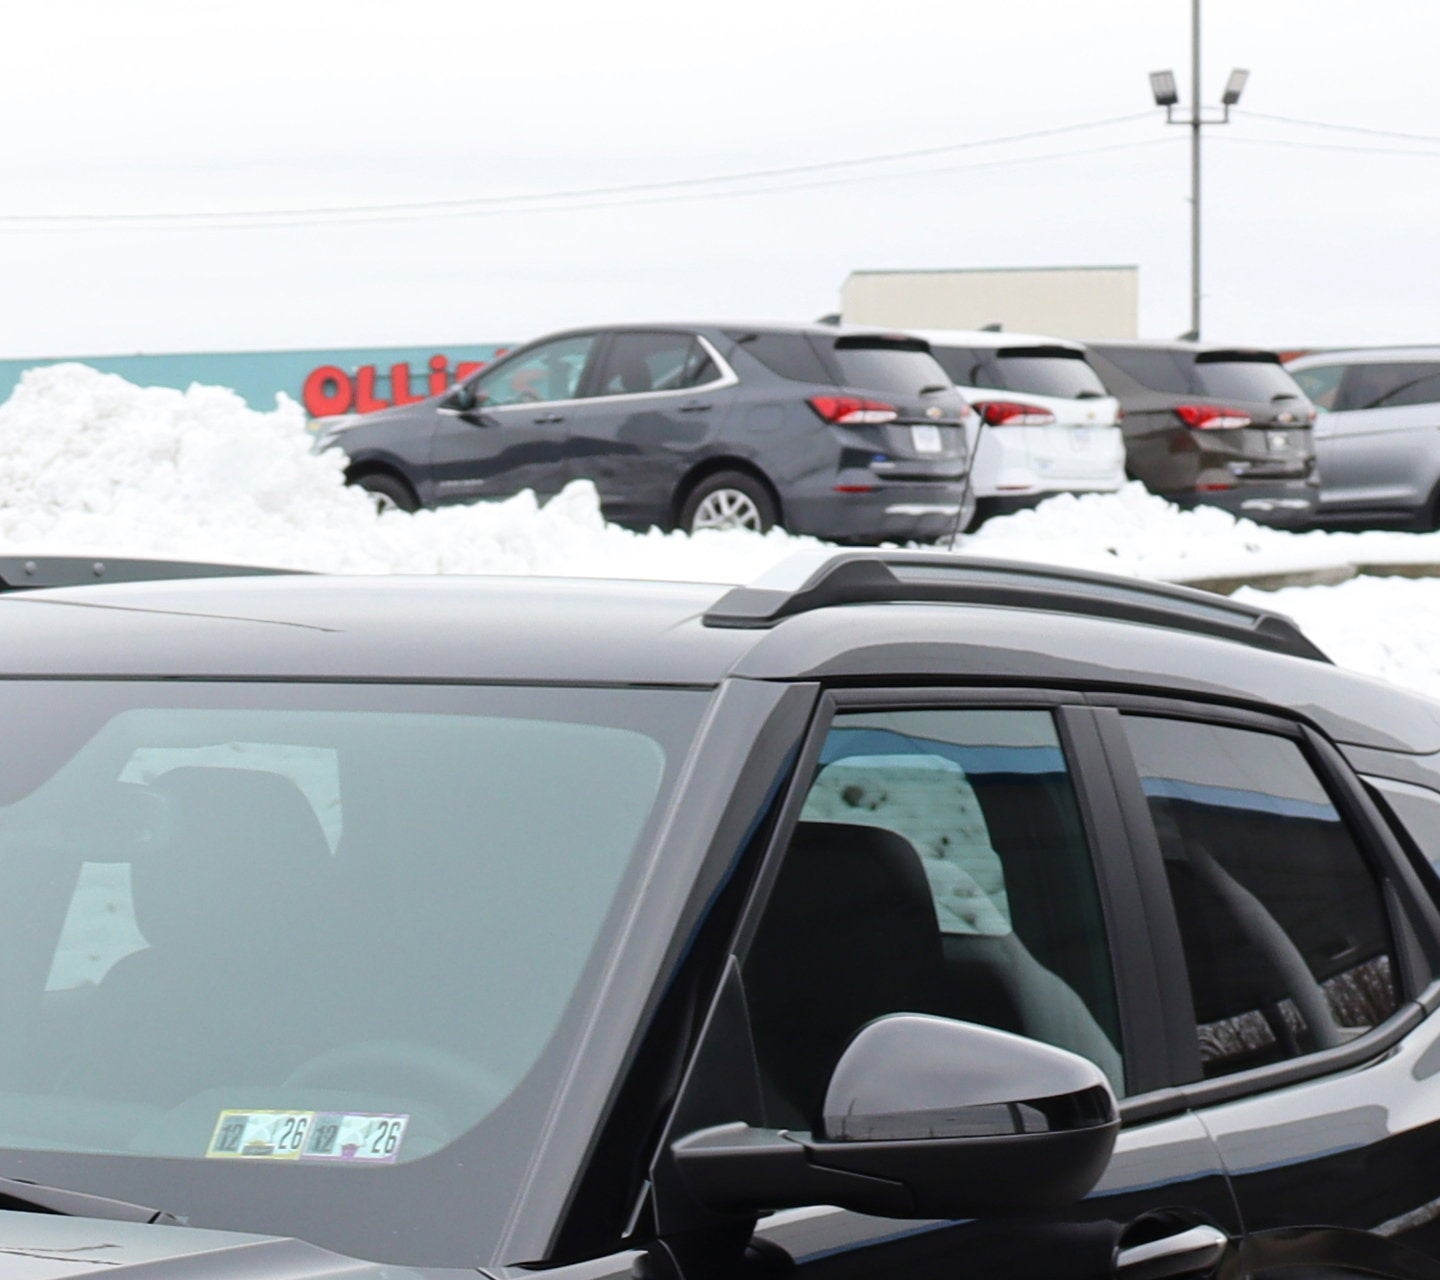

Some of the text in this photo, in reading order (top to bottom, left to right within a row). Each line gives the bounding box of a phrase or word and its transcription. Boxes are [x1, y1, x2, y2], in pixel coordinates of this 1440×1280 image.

[220, 1117, 308, 1151] 12 26
[315, 1120, 402, 1154] 12 26
